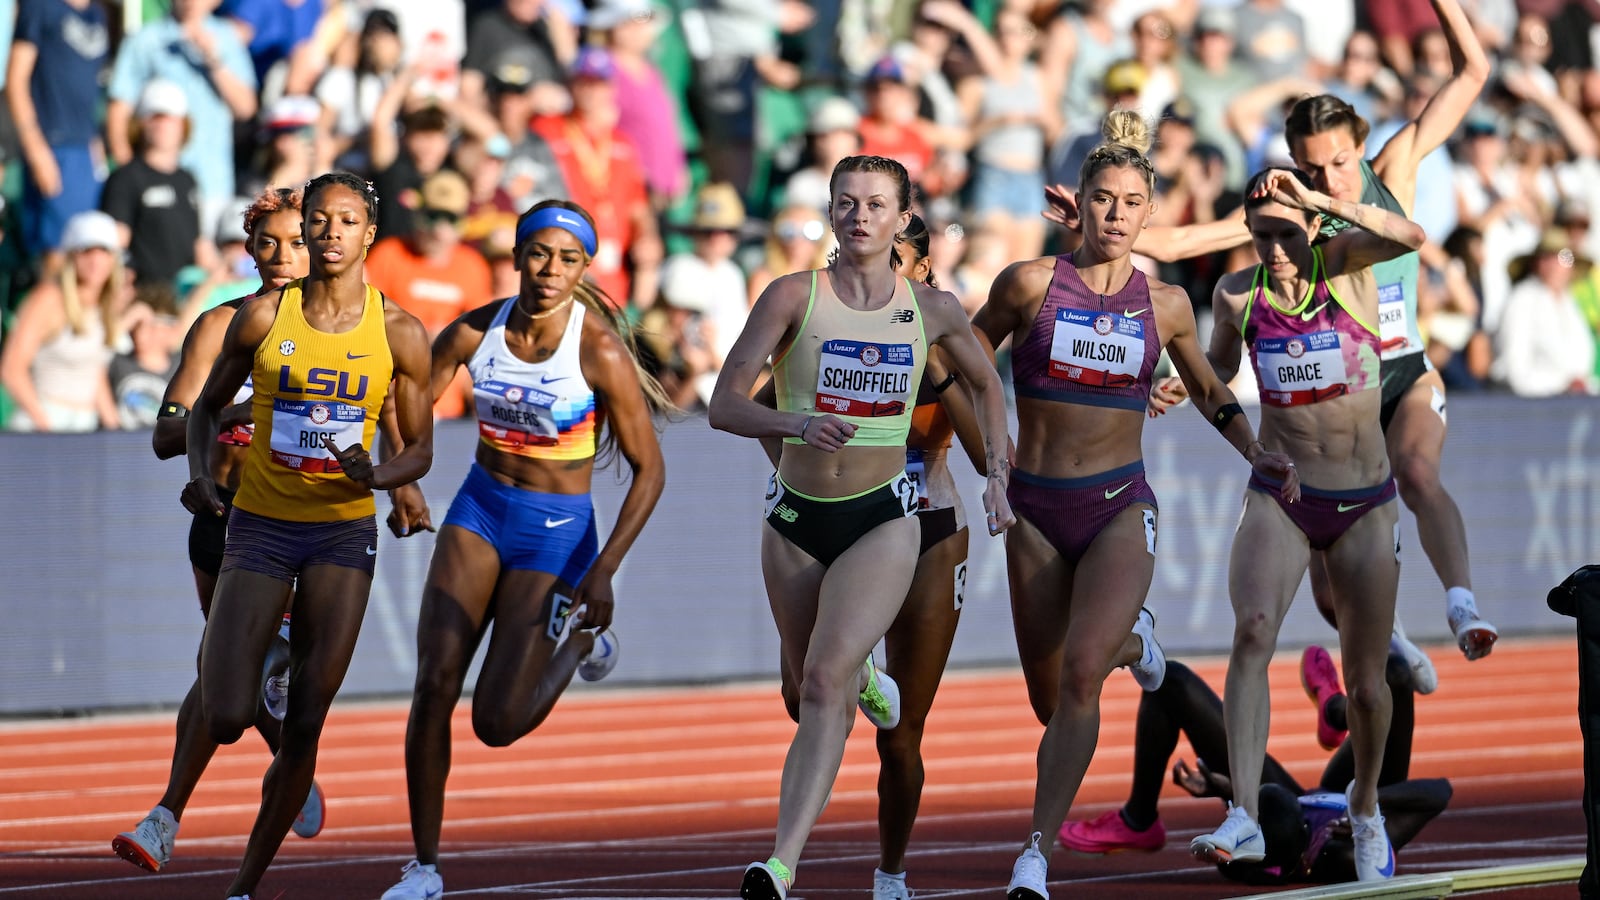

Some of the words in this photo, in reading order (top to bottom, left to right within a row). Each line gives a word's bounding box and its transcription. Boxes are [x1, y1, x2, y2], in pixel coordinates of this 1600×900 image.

[1072, 338, 1126, 364] WILSON
[279, 365, 369, 401] LSU
[823, 367, 908, 394] SCHOFFIELD
[1277, 363, 1323, 384] GRACE
[491, 404, 541, 427] ROGERS
